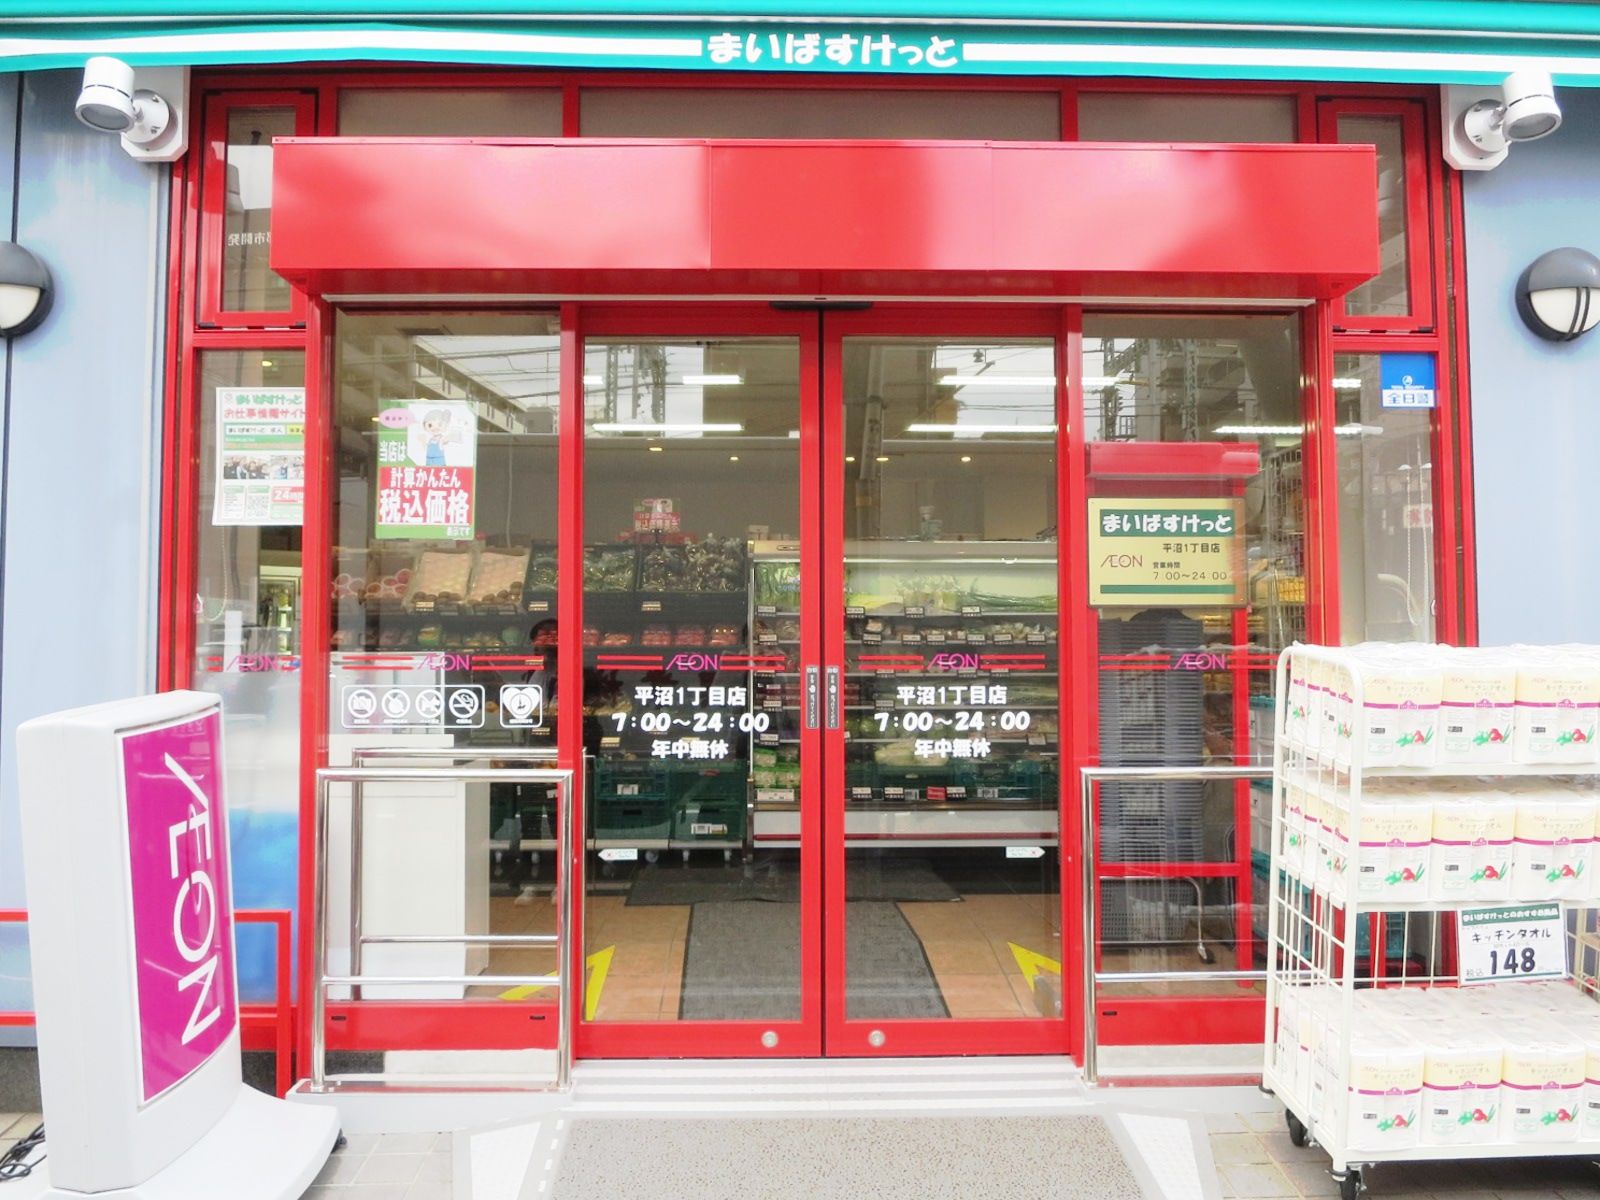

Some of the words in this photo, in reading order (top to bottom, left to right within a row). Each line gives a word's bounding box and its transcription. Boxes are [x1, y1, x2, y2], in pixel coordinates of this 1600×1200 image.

[707, 33, 958, 68] まいばすけっと
[390, 467, 461, 488] 計算かんたん
[380, 489, 470, 526] 税込価格
[1102, 514, 1232, 533] まいばすけっと
[1162, 543, 1221, 554] 平沼1丁目店
[634, 686, 747, 706] 平沼1丁目店
[897, 686, 1008, 705] 平沼1丁目店
[651, 739, 729, 759] 年中無休
[914, 739, 991, 758] 年中無休
[1472, 928, 1551, 942] キッチンタオル
[1490, 947, 1536, 975] 148
